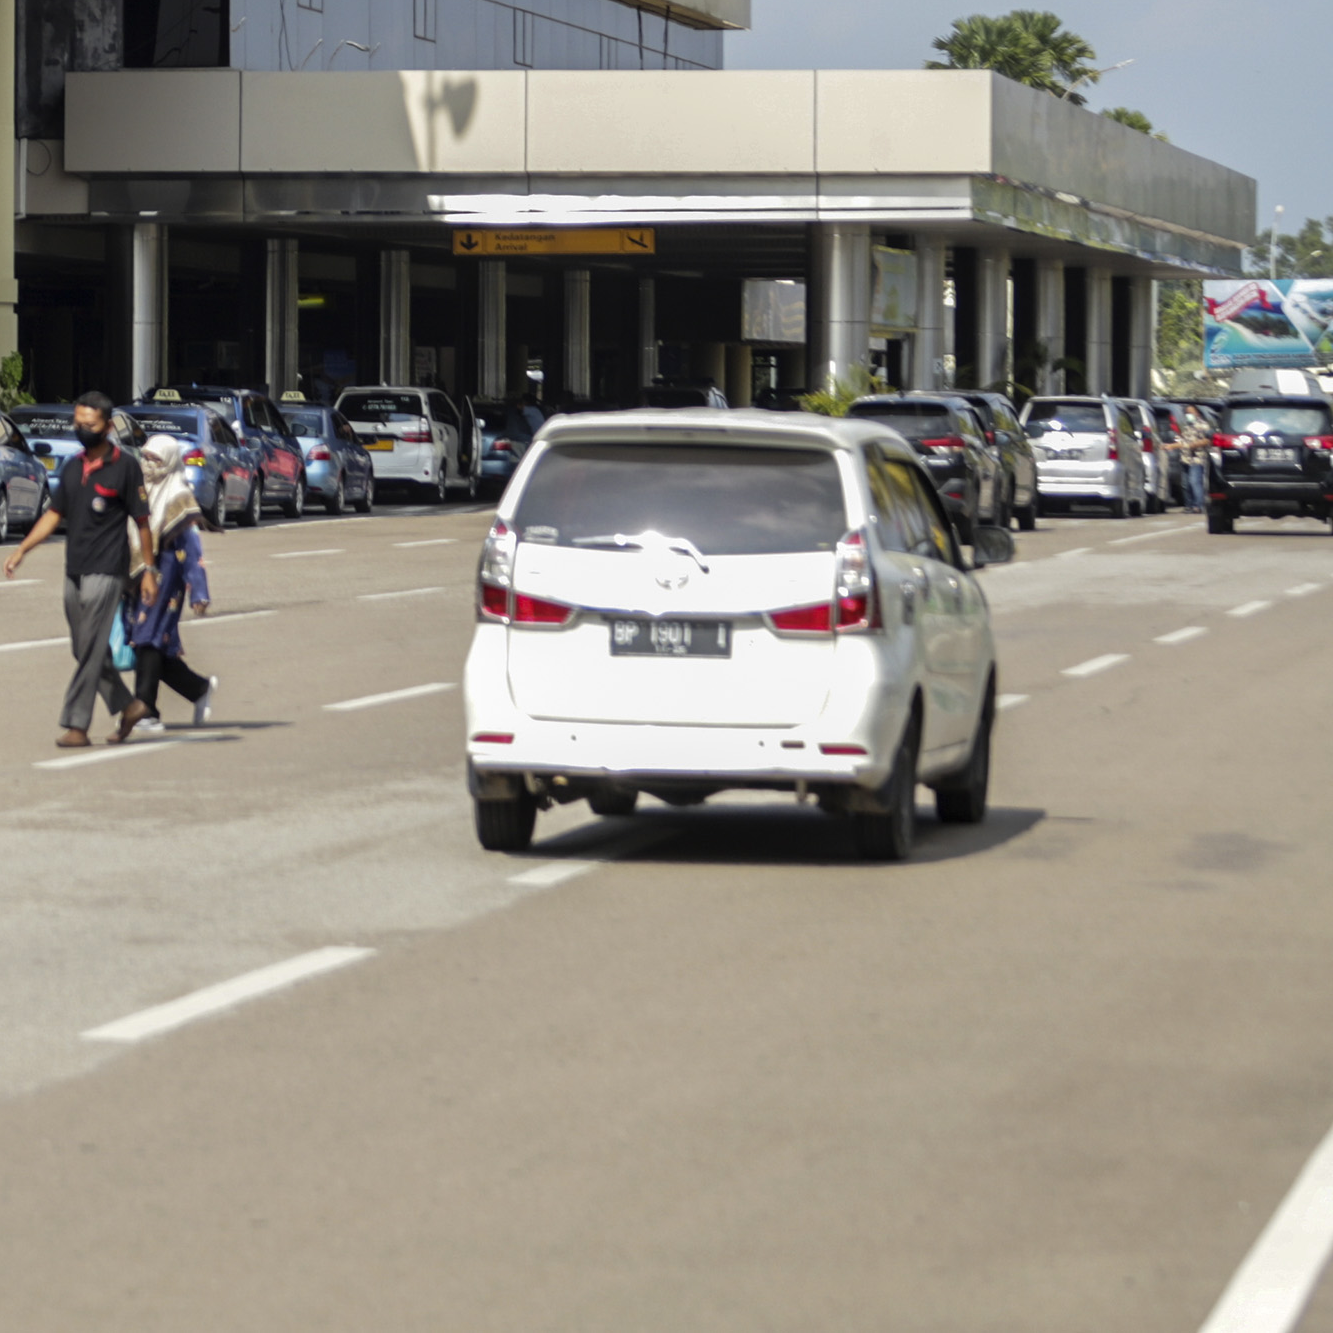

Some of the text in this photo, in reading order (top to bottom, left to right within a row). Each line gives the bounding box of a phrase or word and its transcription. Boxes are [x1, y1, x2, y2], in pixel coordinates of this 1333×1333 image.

[494, 232, 556, 243] Kedatangan
[494, 243, 528, 252] Arrival
[614, 620, 640, 645] BP
